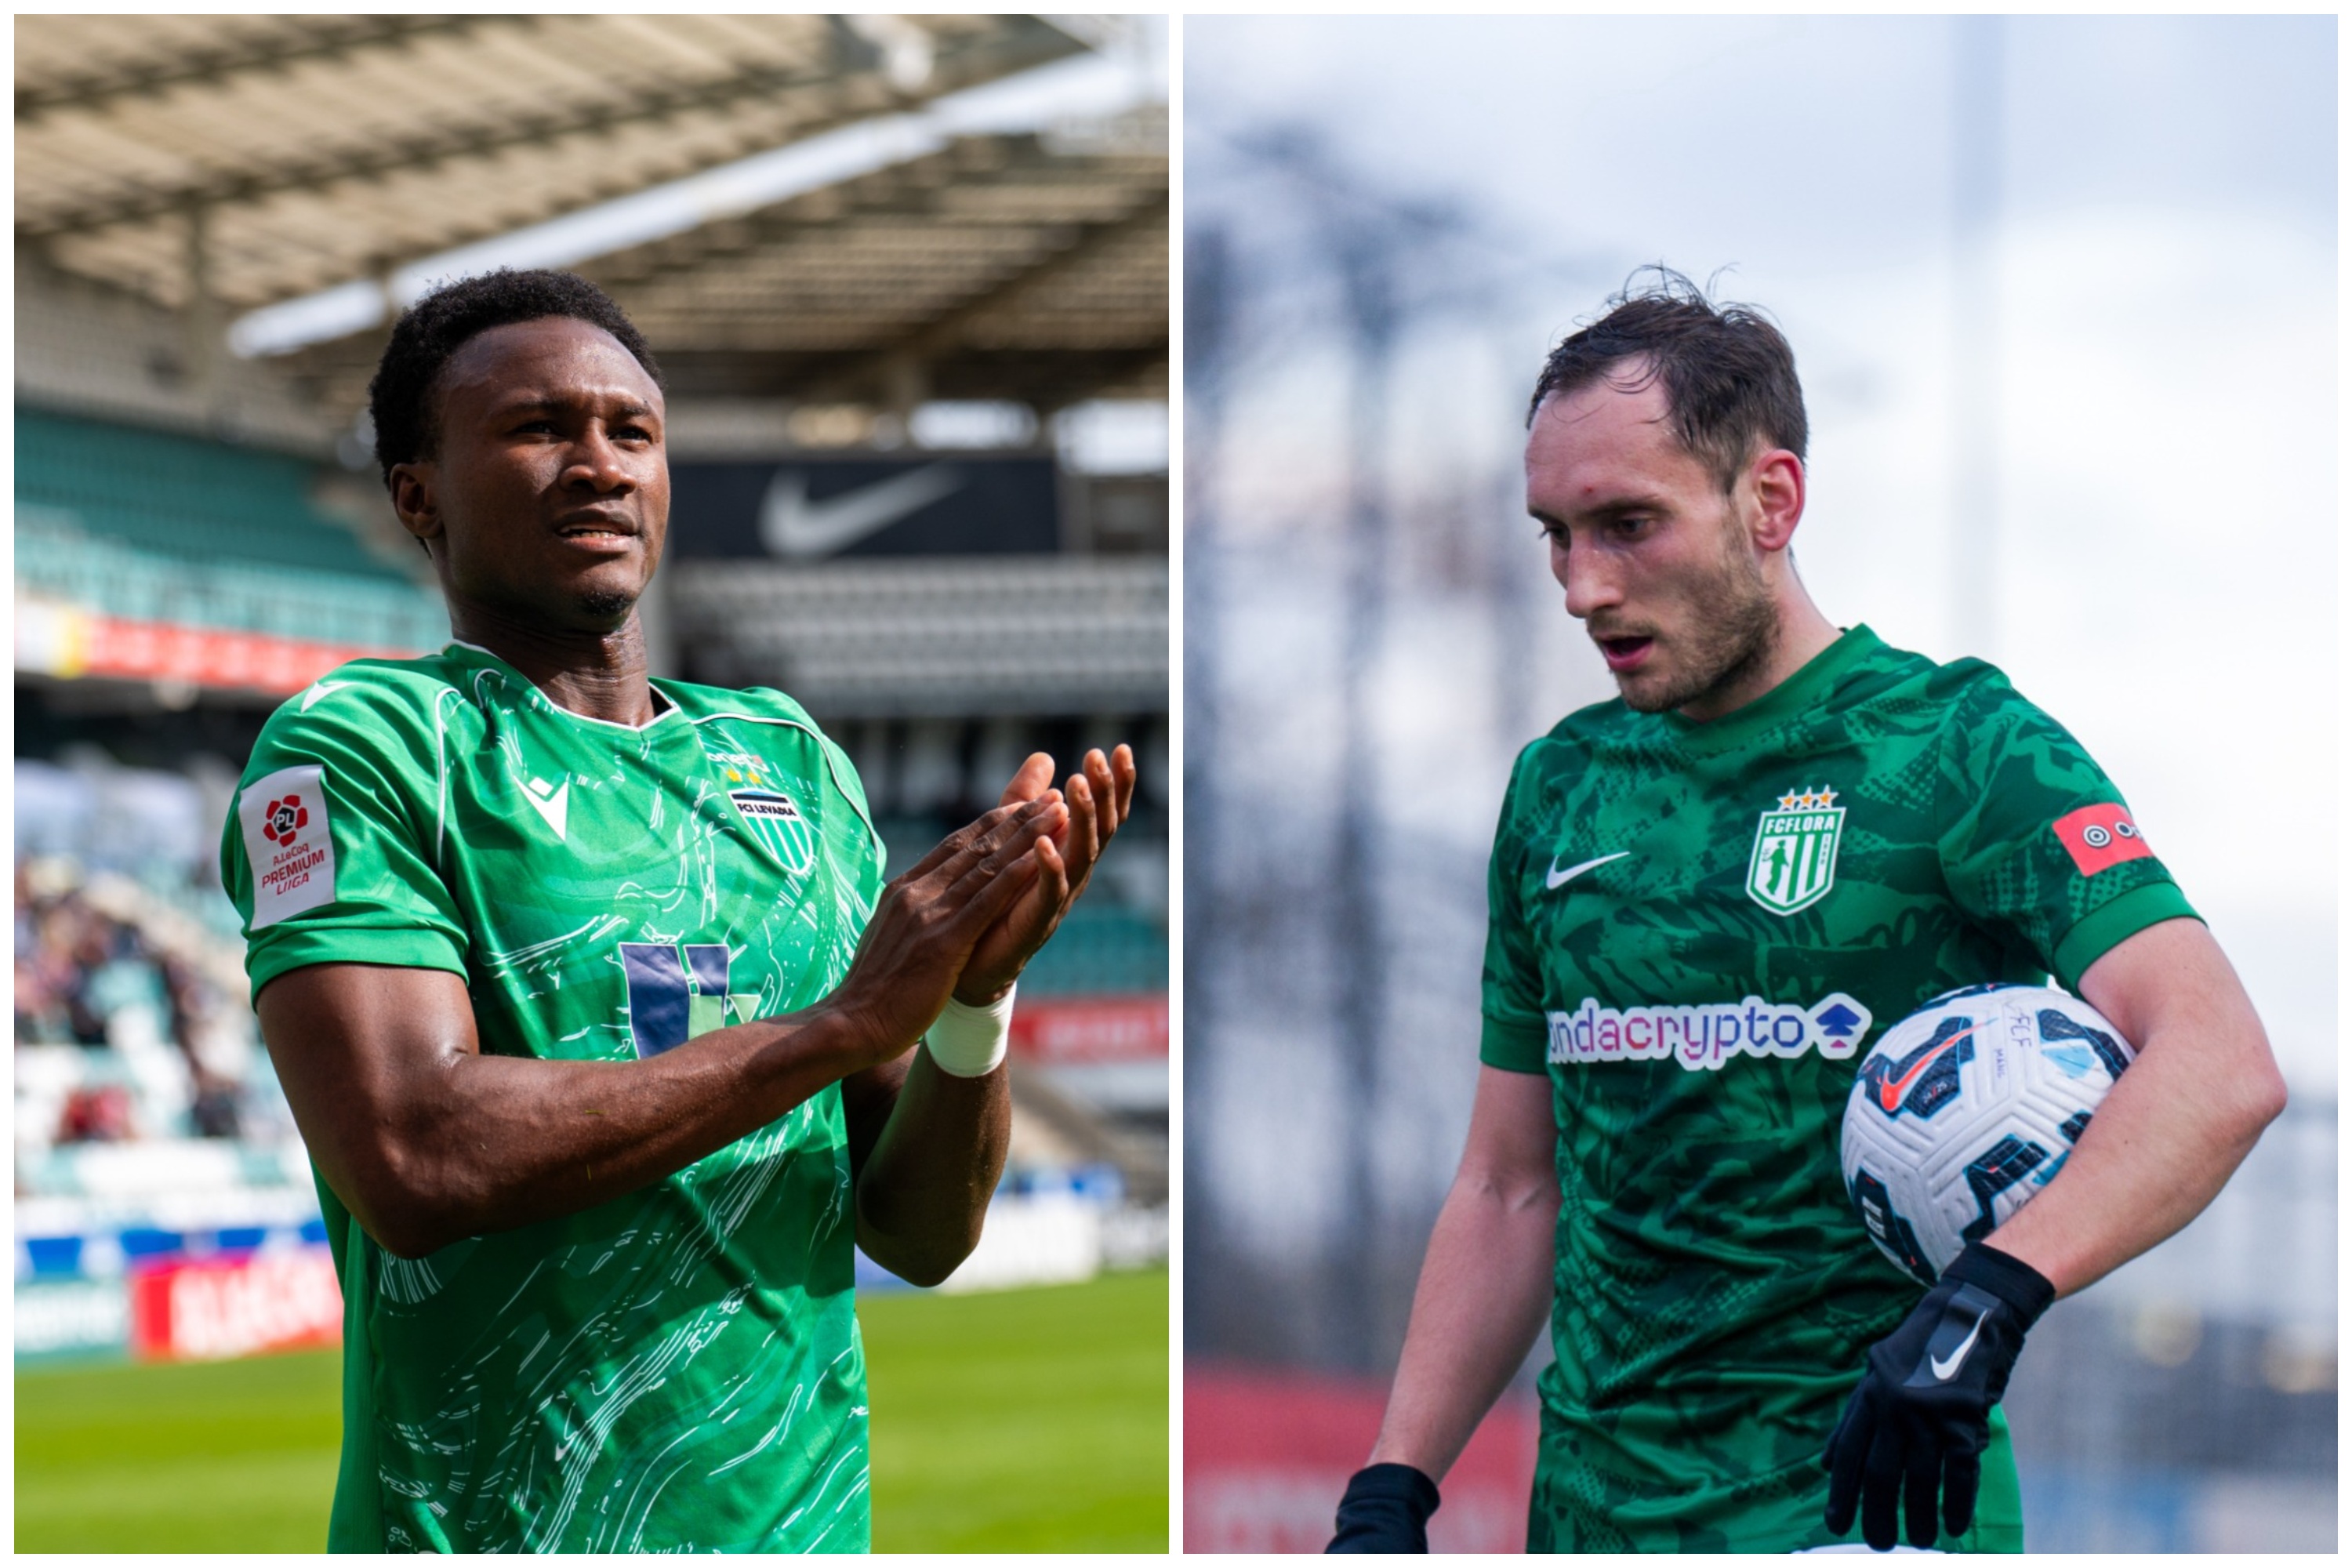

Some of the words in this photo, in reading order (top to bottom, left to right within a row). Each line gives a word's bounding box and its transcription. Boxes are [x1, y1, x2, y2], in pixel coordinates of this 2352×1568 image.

[737, 804, 753, 812] FCI
[755, 805, 797, 816] LEVADIA
[276, 813, 292, 827] PL
[263, 849, 325, 887] PREMIUM
[277, 873, 309, 895] LIIGA
